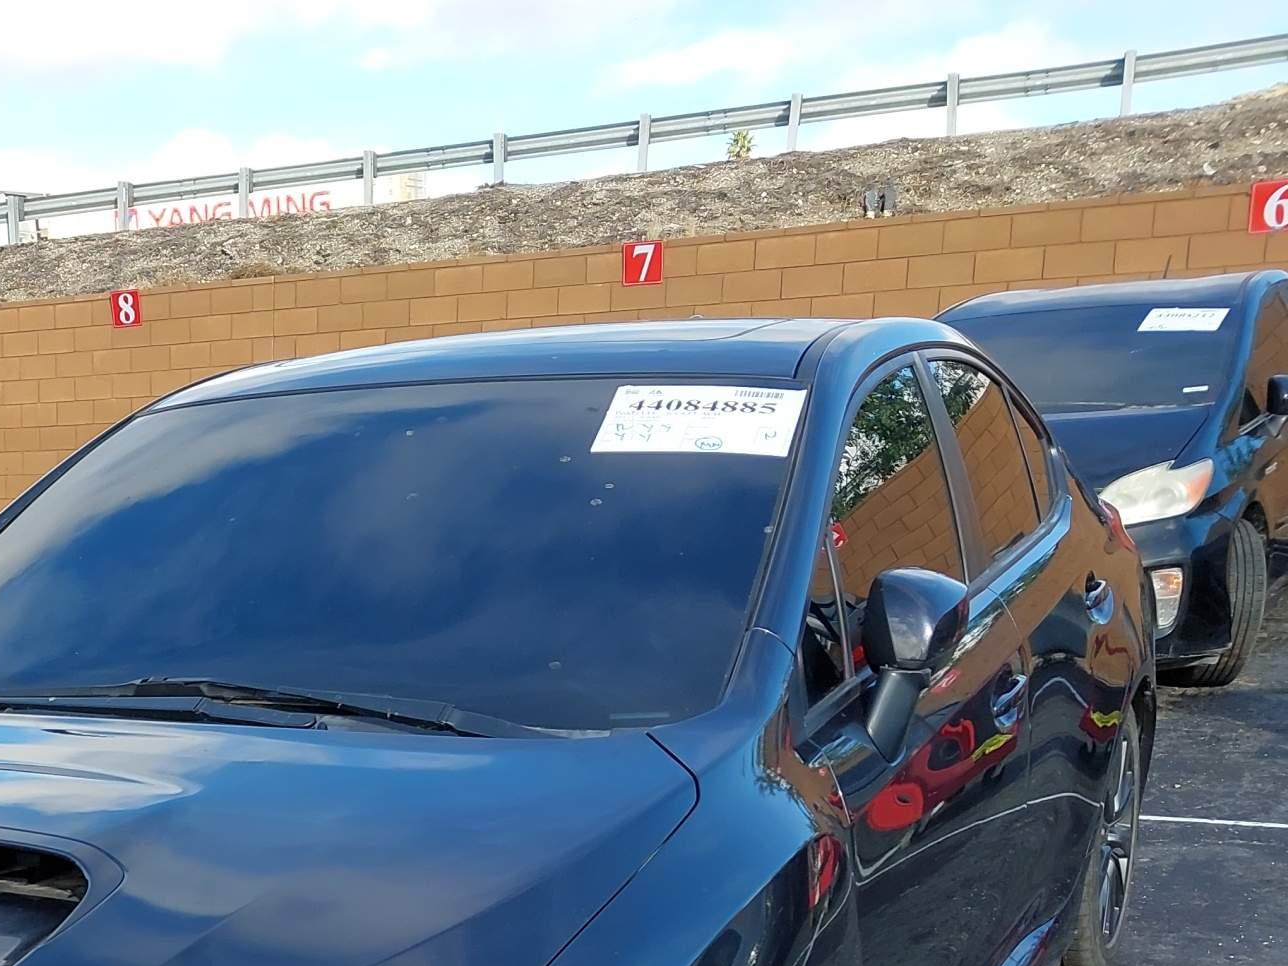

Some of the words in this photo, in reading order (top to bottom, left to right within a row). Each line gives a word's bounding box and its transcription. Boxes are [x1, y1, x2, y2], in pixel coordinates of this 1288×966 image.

[149, 202, 232, 226] YANG
[1263, 184, 1288, 228] 6
[633, 246, 654, 281] 7
[116, 291, 137, 324] 8
[629, 399, 778, 414] 44084885
